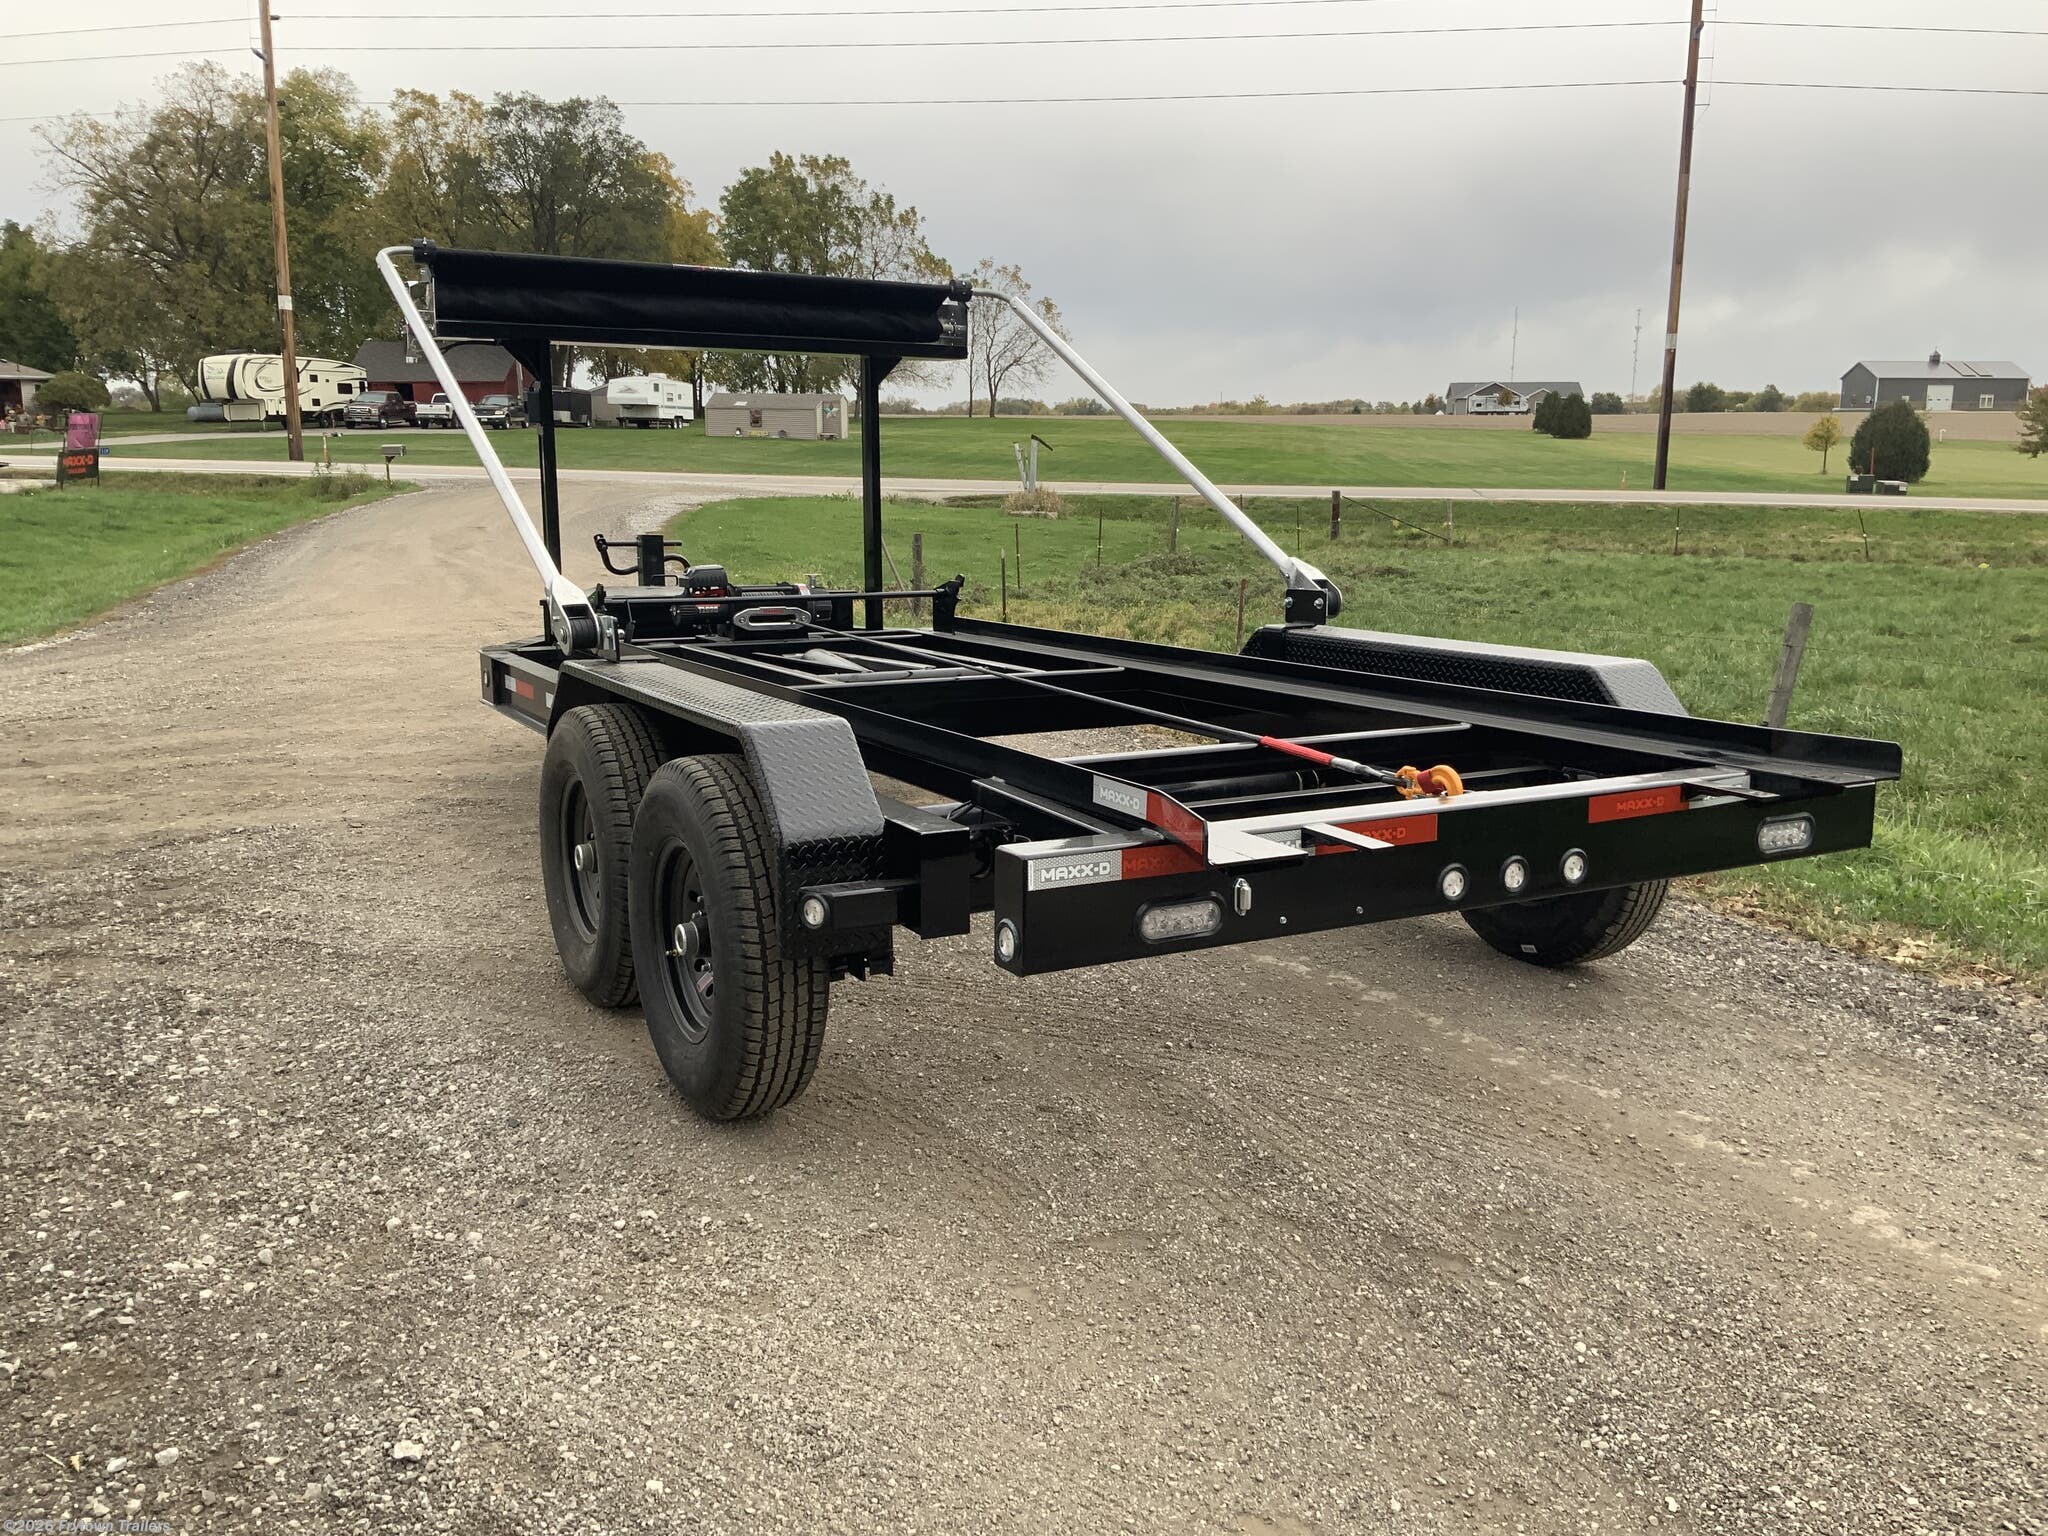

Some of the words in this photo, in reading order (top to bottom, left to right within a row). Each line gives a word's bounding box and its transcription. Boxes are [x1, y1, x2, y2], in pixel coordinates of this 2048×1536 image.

[1099, 786, 1140, 810] MAXX-D
[1616, 796, 1665, 812] MAXX-D
[1040, 861, 1112, 883] MAXX-D
